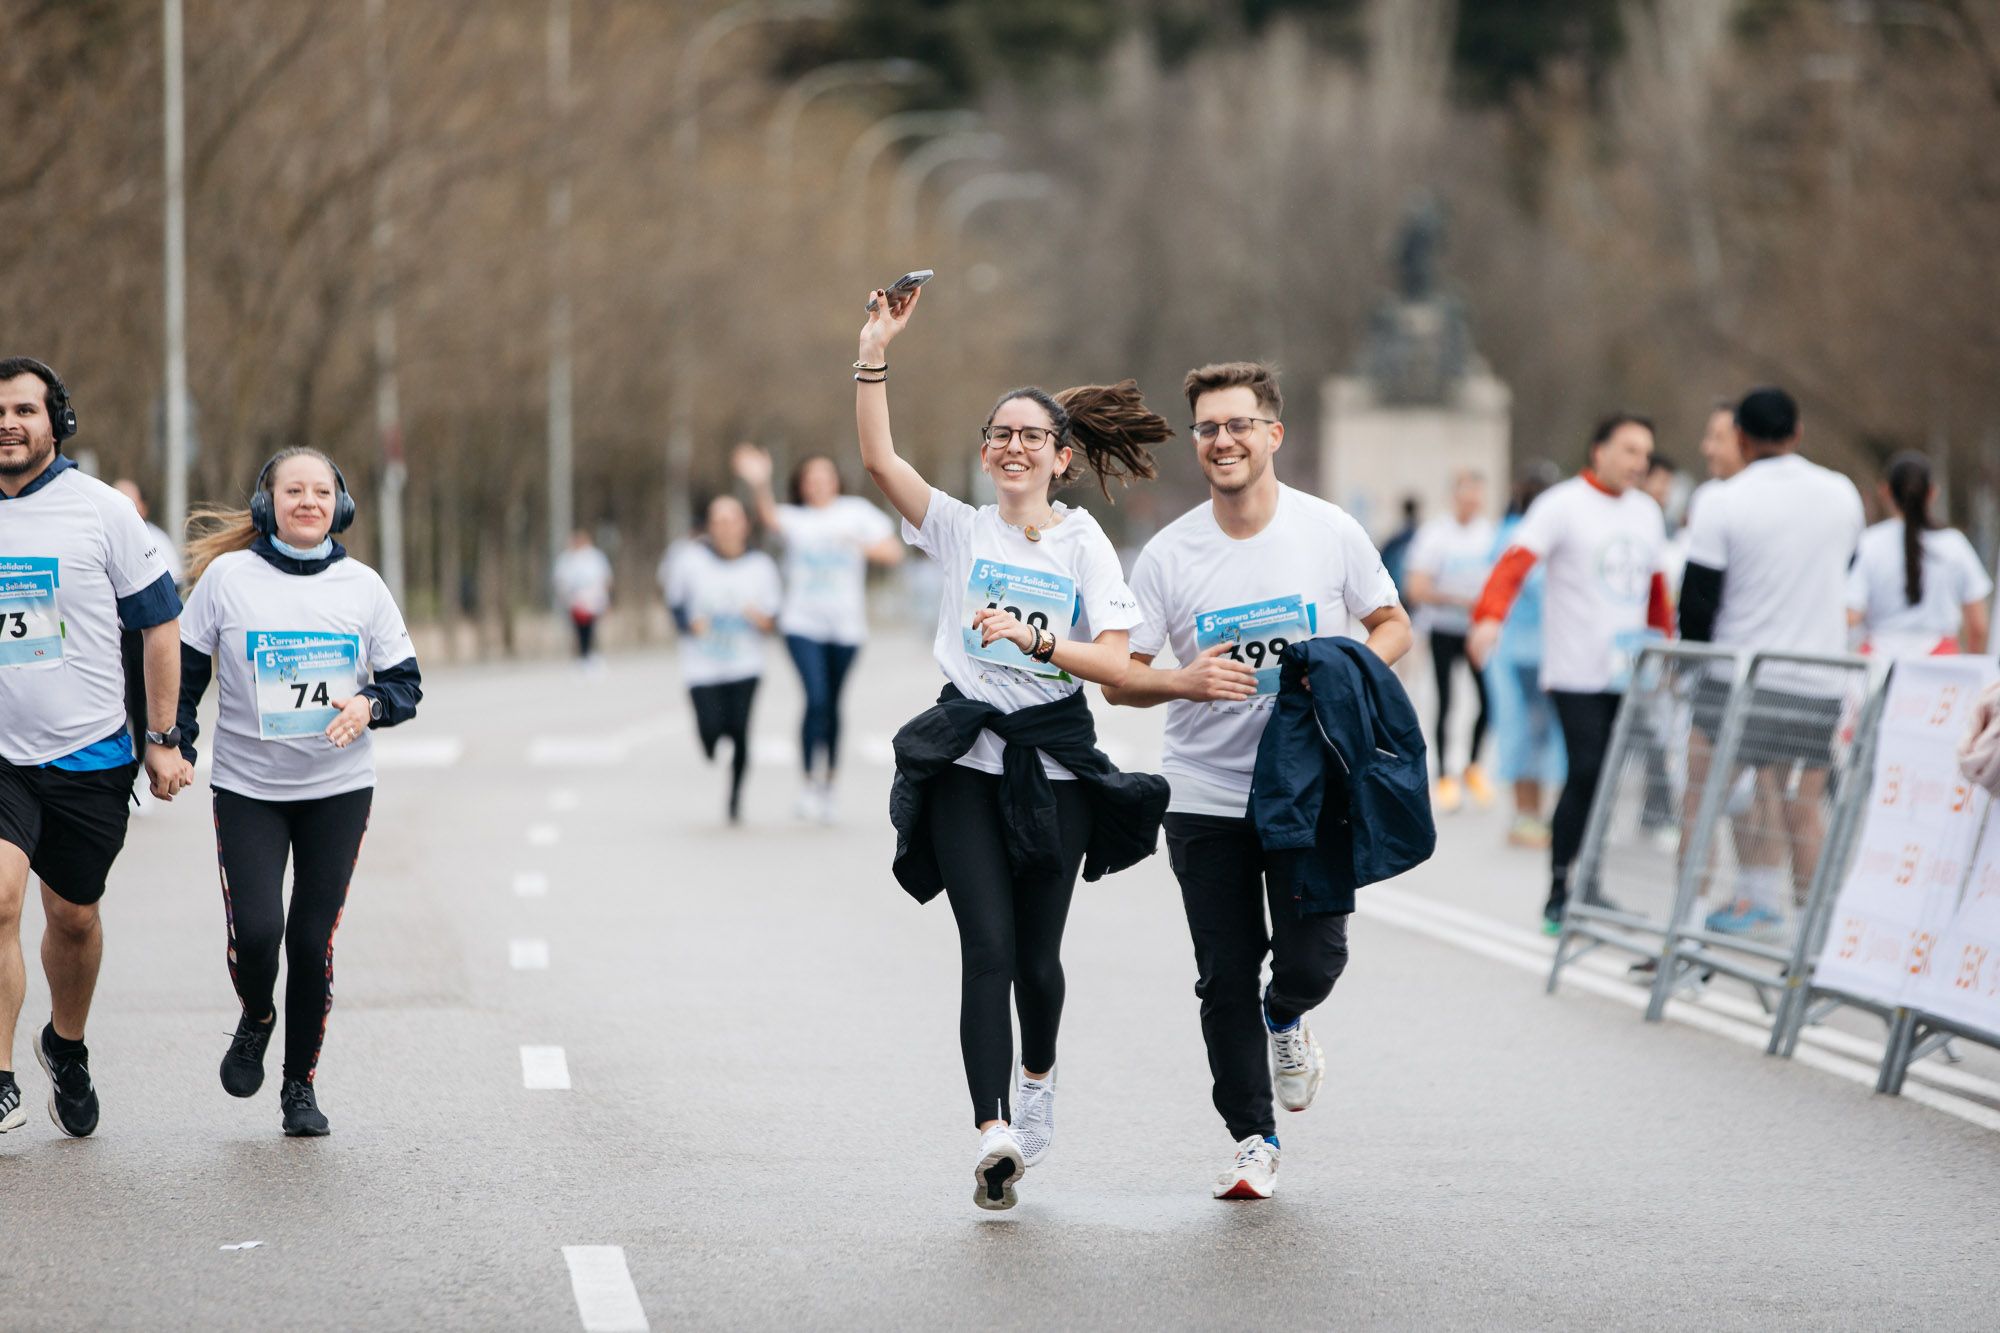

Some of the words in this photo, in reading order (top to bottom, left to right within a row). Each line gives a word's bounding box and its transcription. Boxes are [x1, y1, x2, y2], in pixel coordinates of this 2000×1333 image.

[990, 568, 1021, 584] Carrera
[1022, 575, 1060, 590] Solidaria
[1216, 614, 1249, 626] Carrera
[1249, 605, 1287, 619] Solidaria
[290, 681, 330, 709] 74
